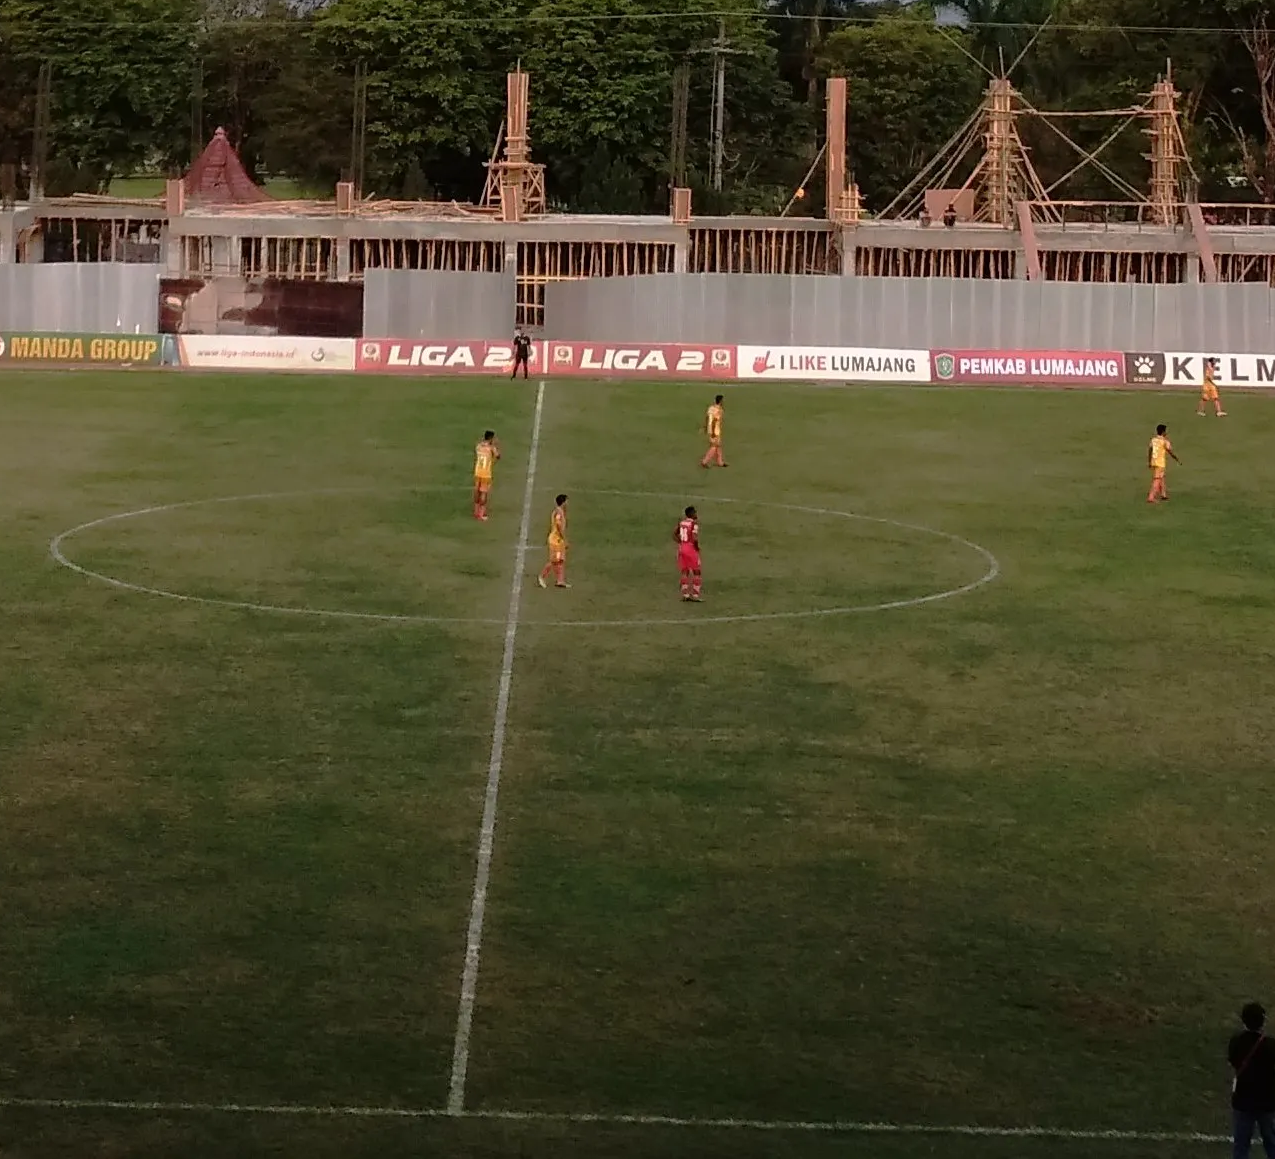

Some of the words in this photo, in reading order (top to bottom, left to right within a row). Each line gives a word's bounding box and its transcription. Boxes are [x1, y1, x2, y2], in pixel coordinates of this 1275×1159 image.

[10, 337, 84, 359] MANDA
[90, 339, 158, 361] GROUP
[387, 345, 475, 367] LIGA
[483, 347, 514, 367] 2
[579, 348, 668, 371] LIGA
[676, 350, 705, 371] 2
[780, 355, 785, 370] I
[789, 355, 827, 371] LIKE
[831, 355, 915, 372] LUMAJANG
[960, 358, 1026, 375] PEMKAB
[1030, 359, 1118, 377] LUMAJANG
